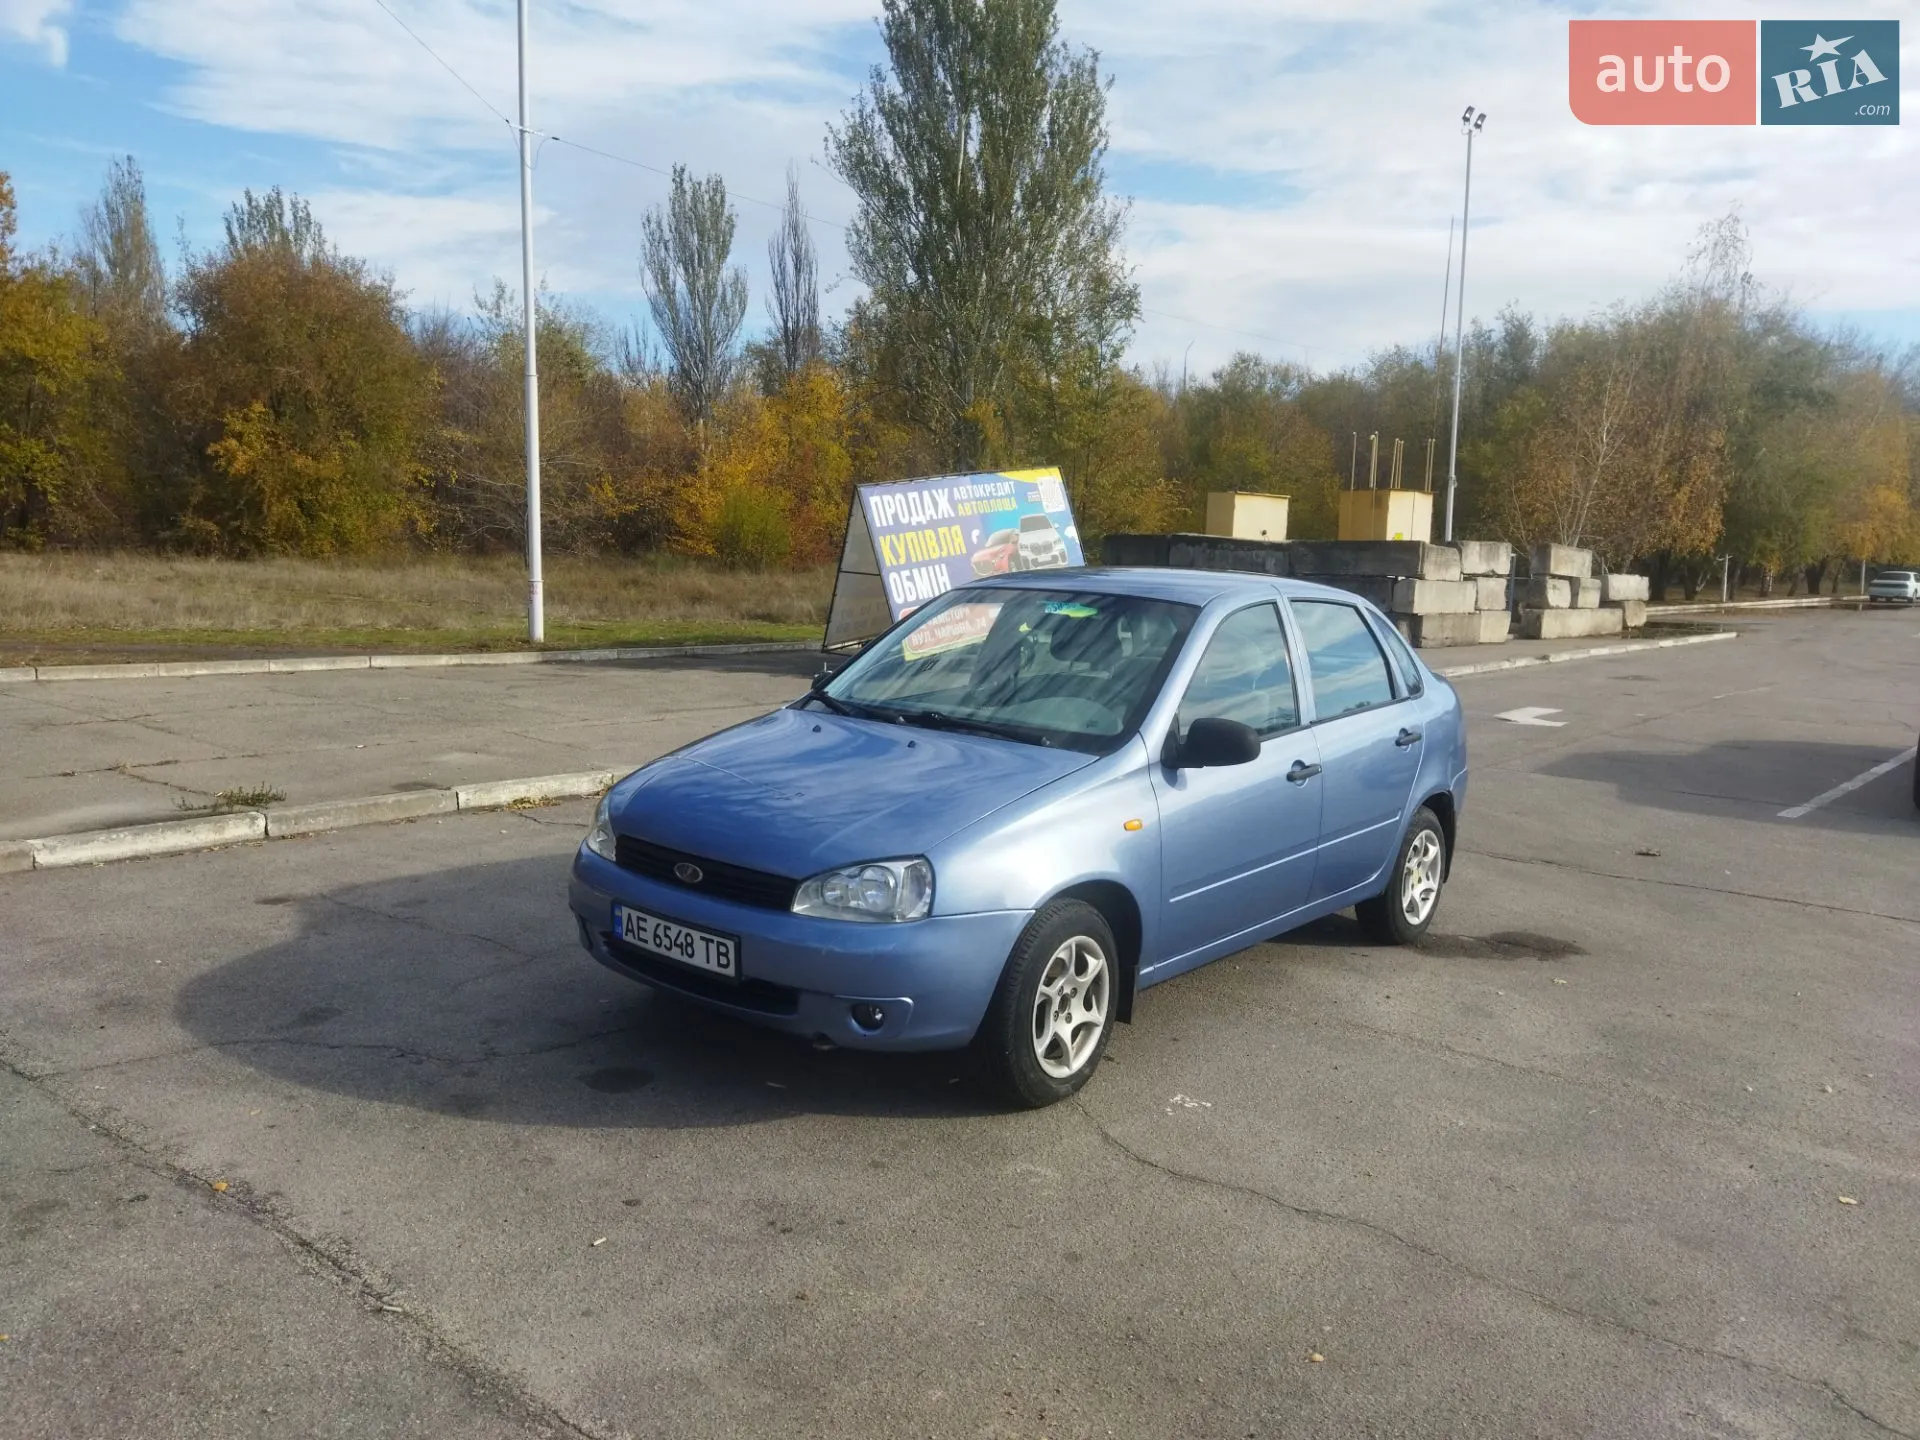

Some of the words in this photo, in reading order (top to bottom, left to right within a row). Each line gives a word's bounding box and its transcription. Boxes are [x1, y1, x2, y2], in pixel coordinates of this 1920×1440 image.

[869, 488, 955, 527] ПРОДАЖ
[953, 481, 1015, 500] АВТОКРЕДИТ
[879, 525, 967, 567] КУПІВЛЯ
[889, 563, 952, 604] ОБМІН
[625, 913, 649, 944] AE
[653, 923, 695, 959] 6548
[700, 935, 731, 969] TB
